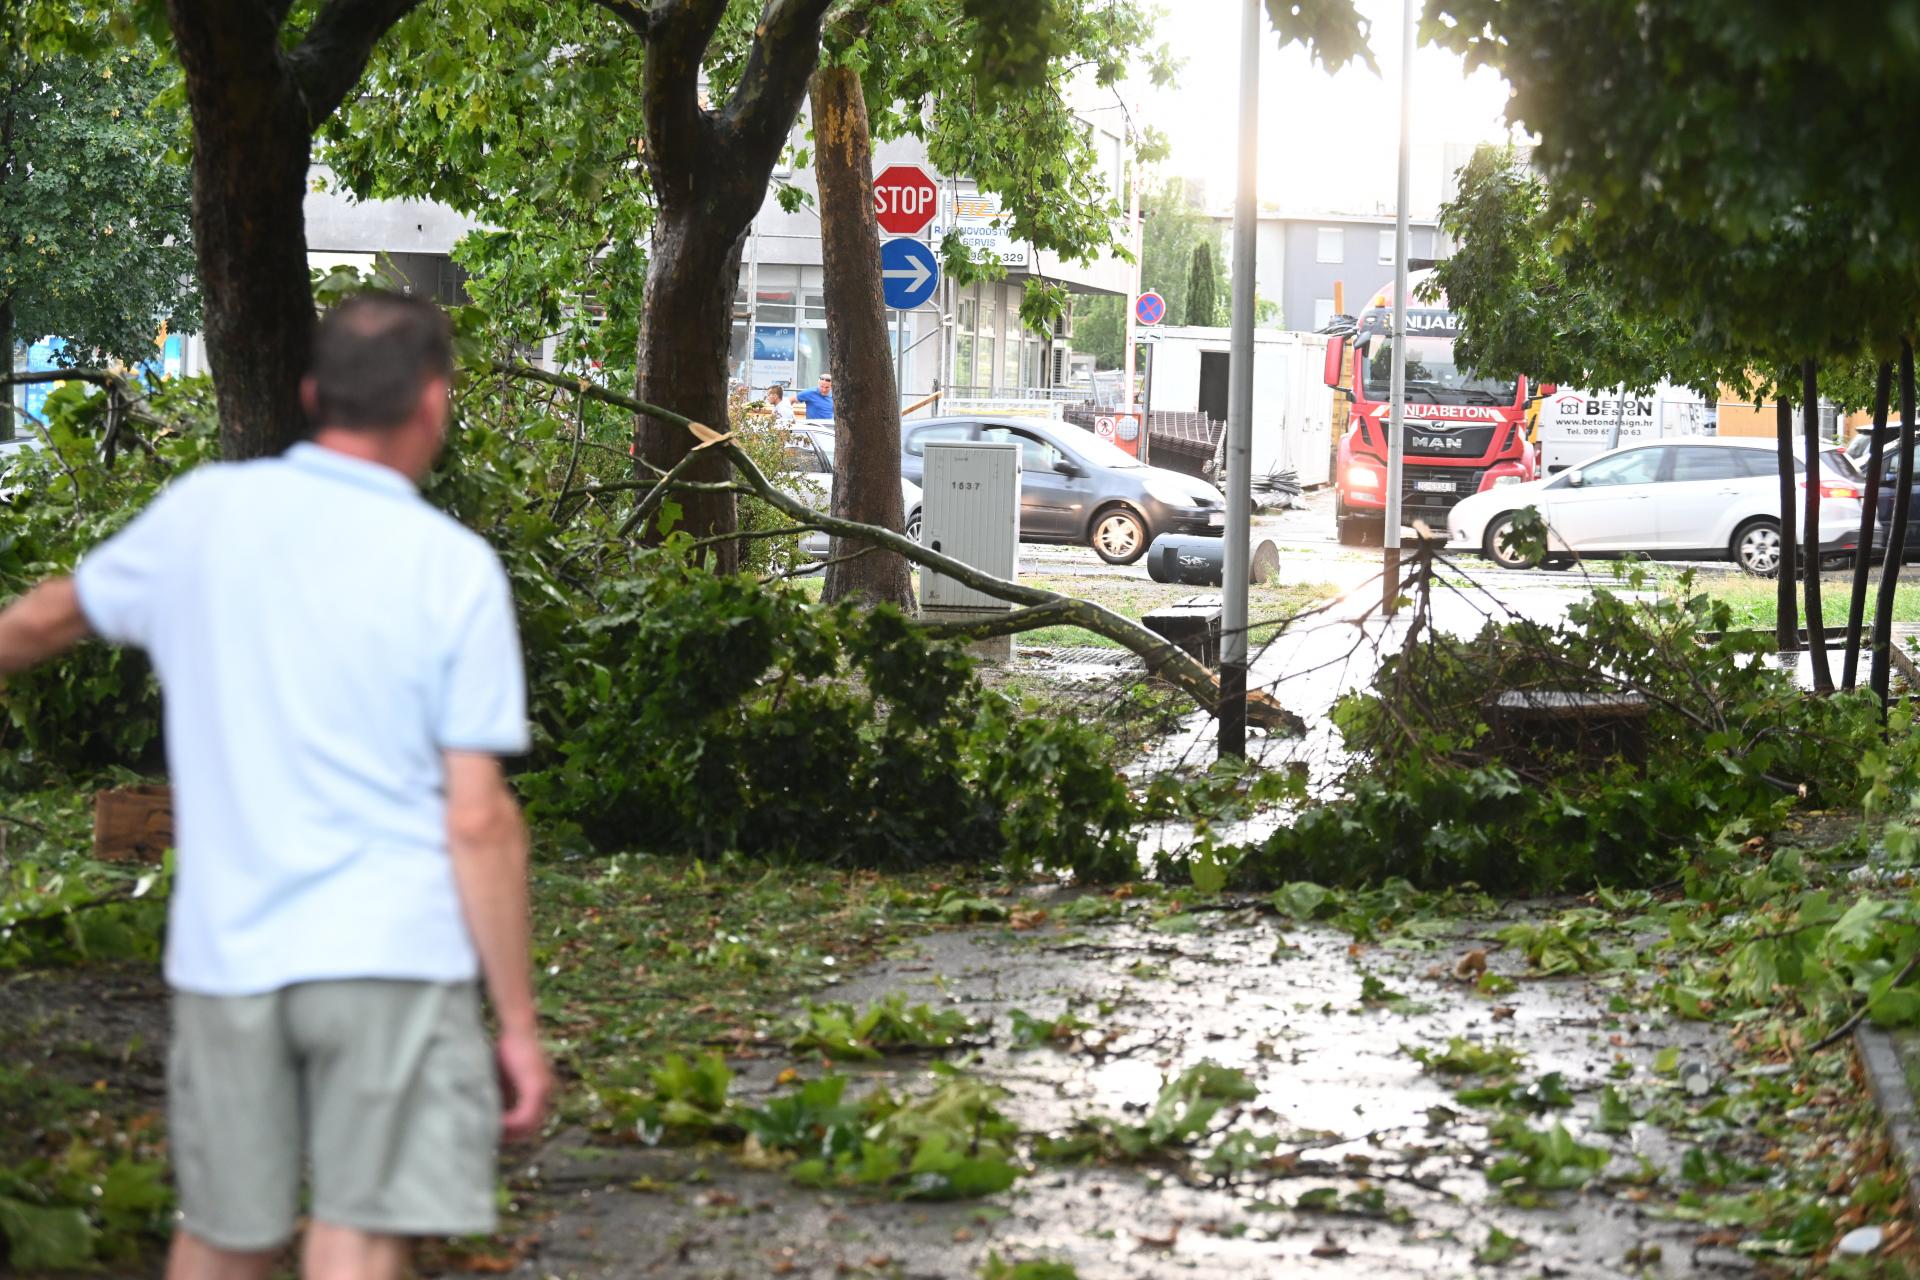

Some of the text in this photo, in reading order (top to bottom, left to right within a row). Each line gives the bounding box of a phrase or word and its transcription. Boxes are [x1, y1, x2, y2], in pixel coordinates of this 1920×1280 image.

[873, 185, 934, 215] STOP
[962, 237, 996, 247] SERVIS
[1002, 253, 1024, 262] 329
[1403, 404, 1491, 418] NIJABETON
[1412, 436, 1462, 449] MAN
